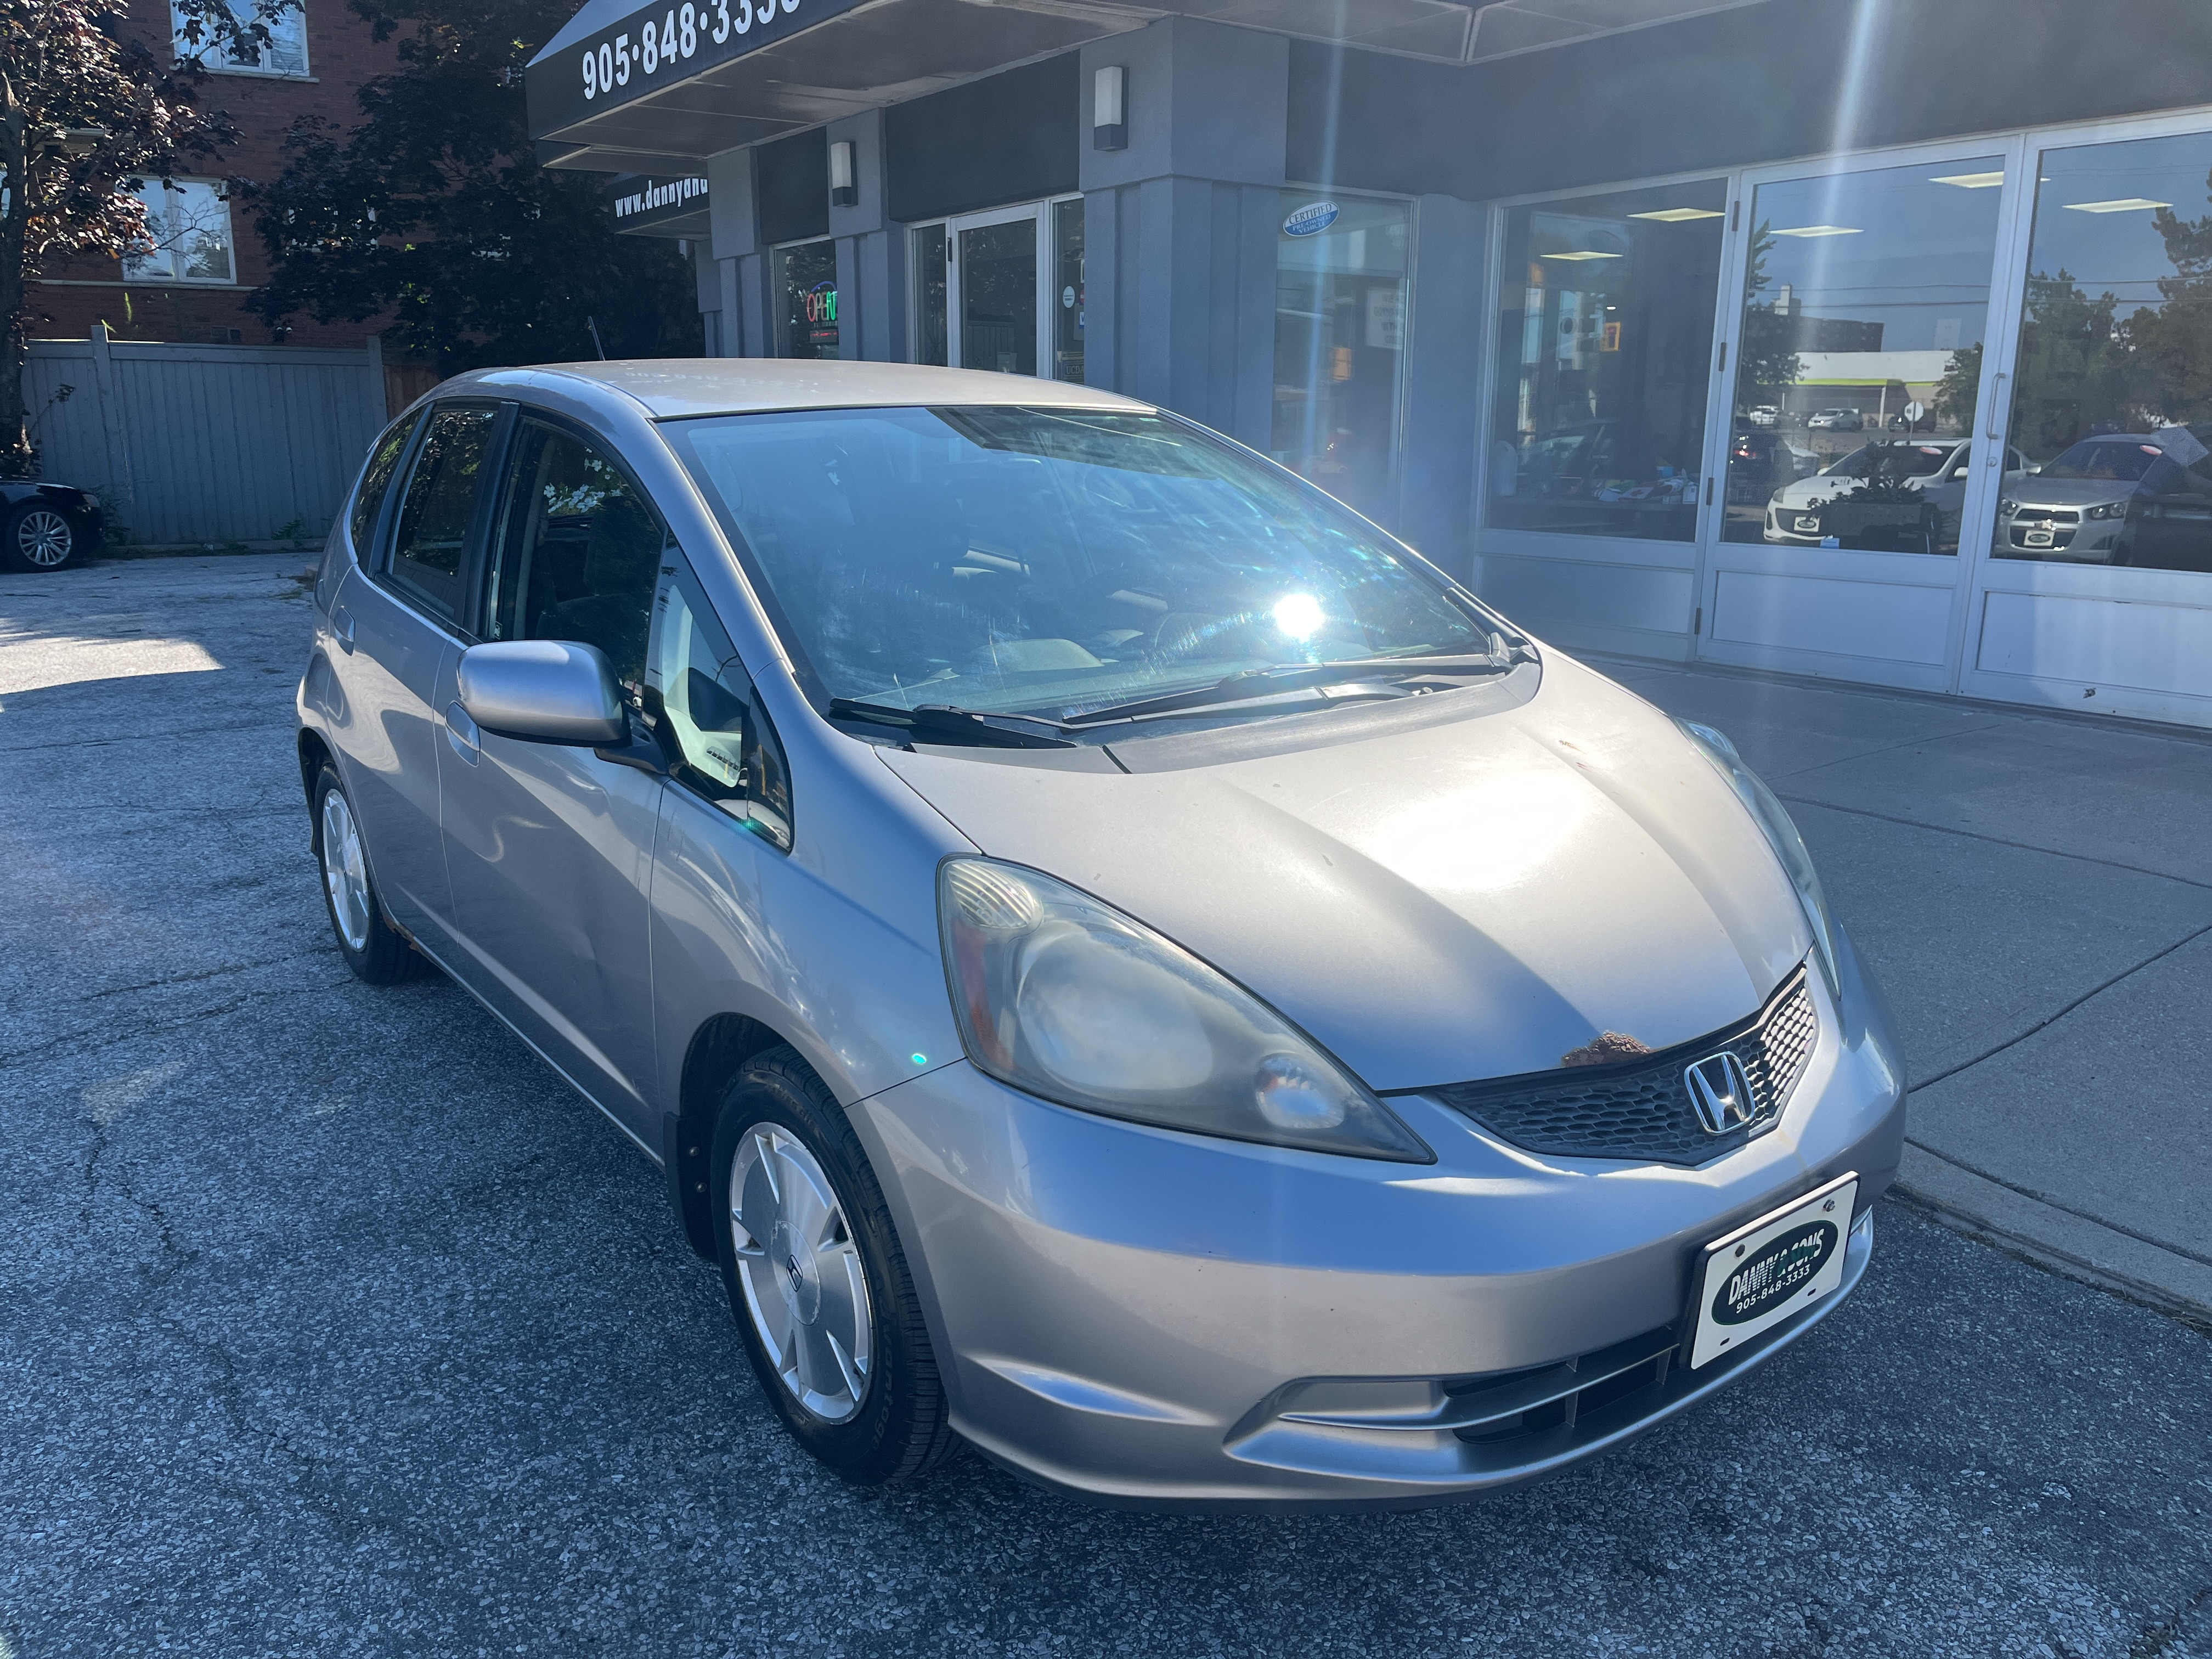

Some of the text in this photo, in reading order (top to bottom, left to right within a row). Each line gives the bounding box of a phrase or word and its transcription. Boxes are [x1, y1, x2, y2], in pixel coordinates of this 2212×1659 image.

[1289, 204, 1332, 224] CERTIFIED
[1292, 214, 1331, 231] PRE-OWNED
[1299, 221, 1325, 233] VEHICLE
[807, 291, 837, 322] OPEN
[1729, 1253, 1779, 1305] DANNY
[1736, 1264, 1810, 1313] 905-848-3333
